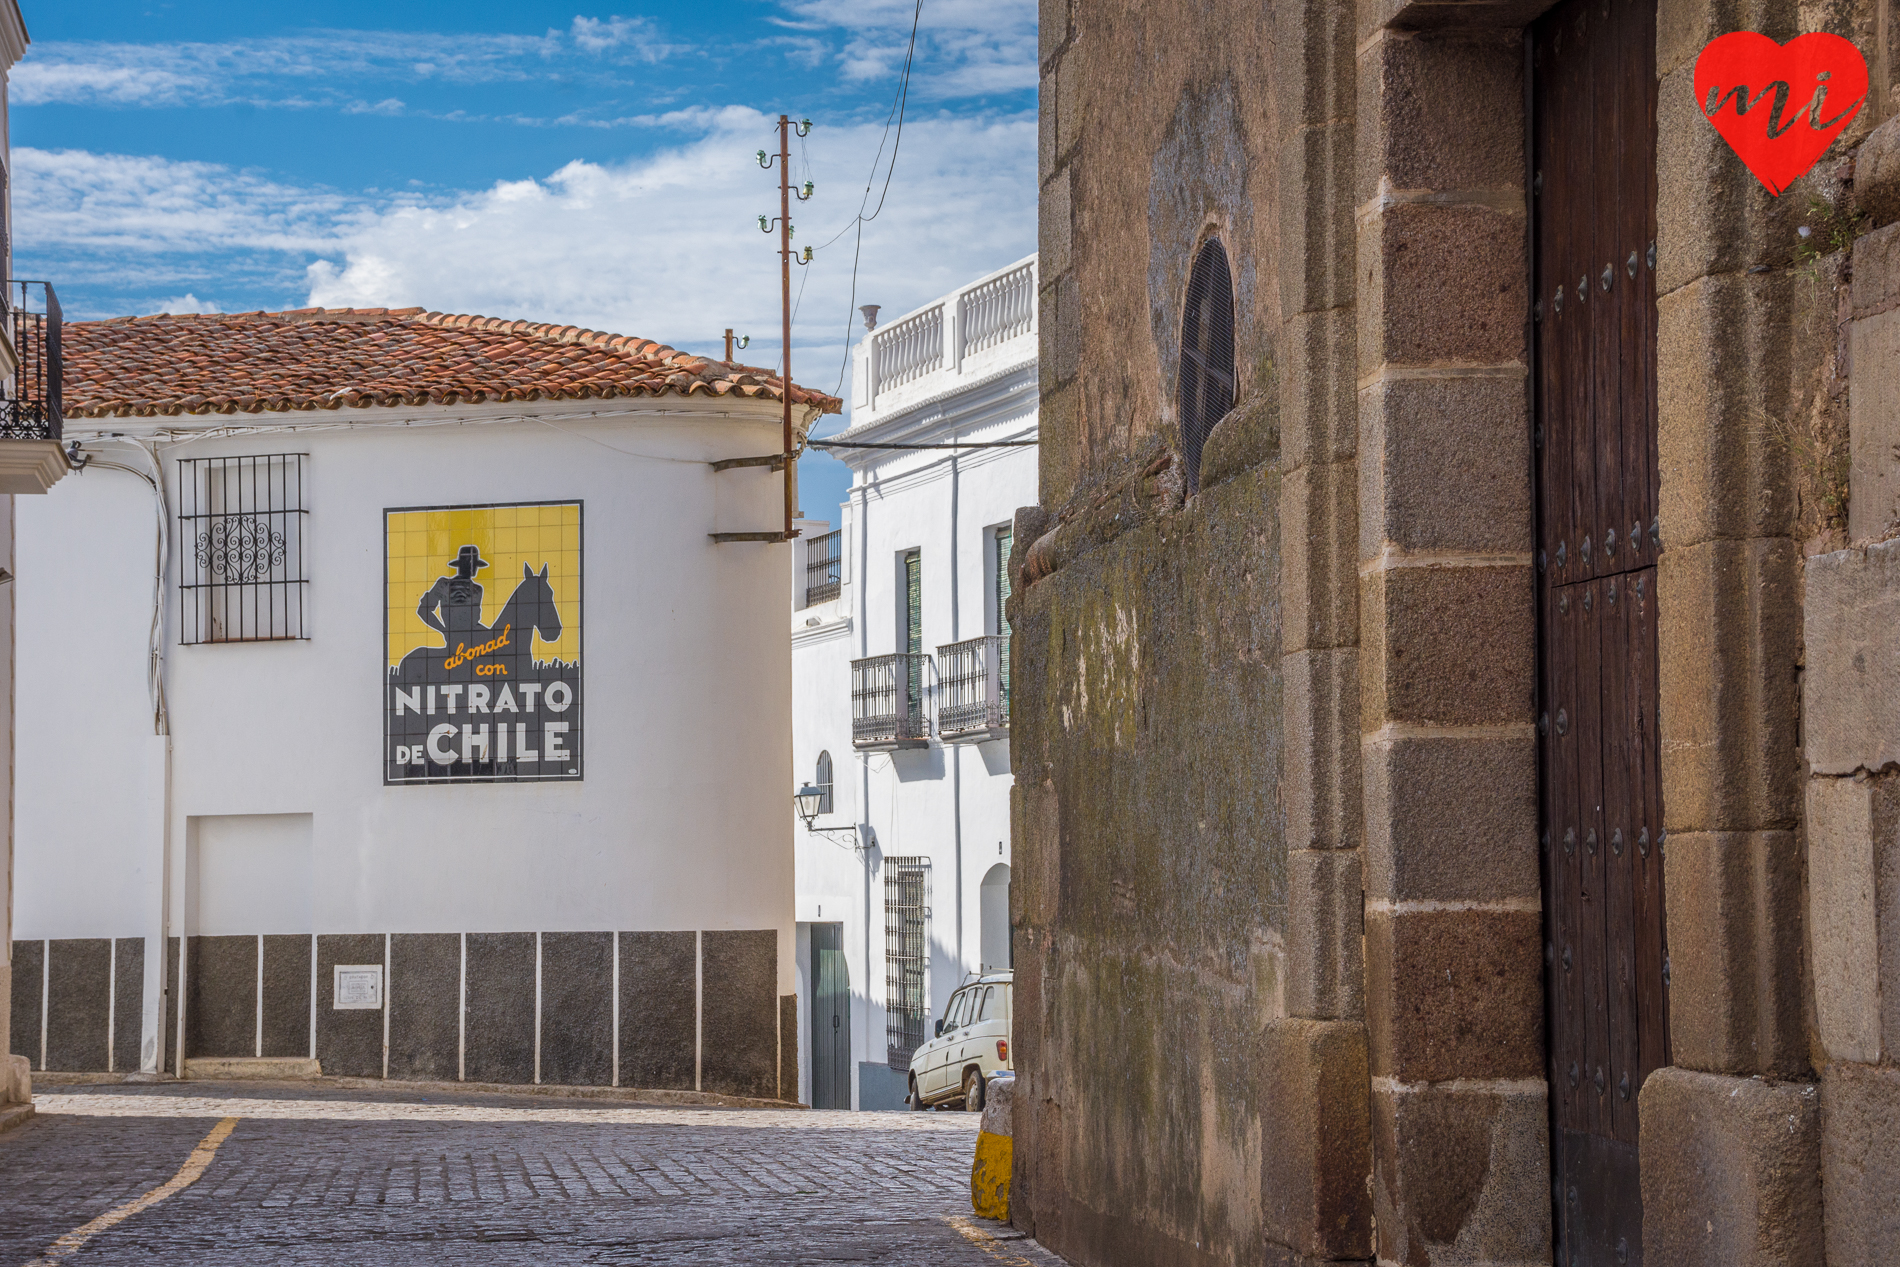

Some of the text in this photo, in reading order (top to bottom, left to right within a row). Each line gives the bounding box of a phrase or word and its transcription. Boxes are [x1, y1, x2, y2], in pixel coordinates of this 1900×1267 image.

[444, 623, 511, 670] abonad
[475, 663, 508, 676] con
[395, 681, 573, 716] NITRATO
[396, 721, 571, 765] DE CHILE
